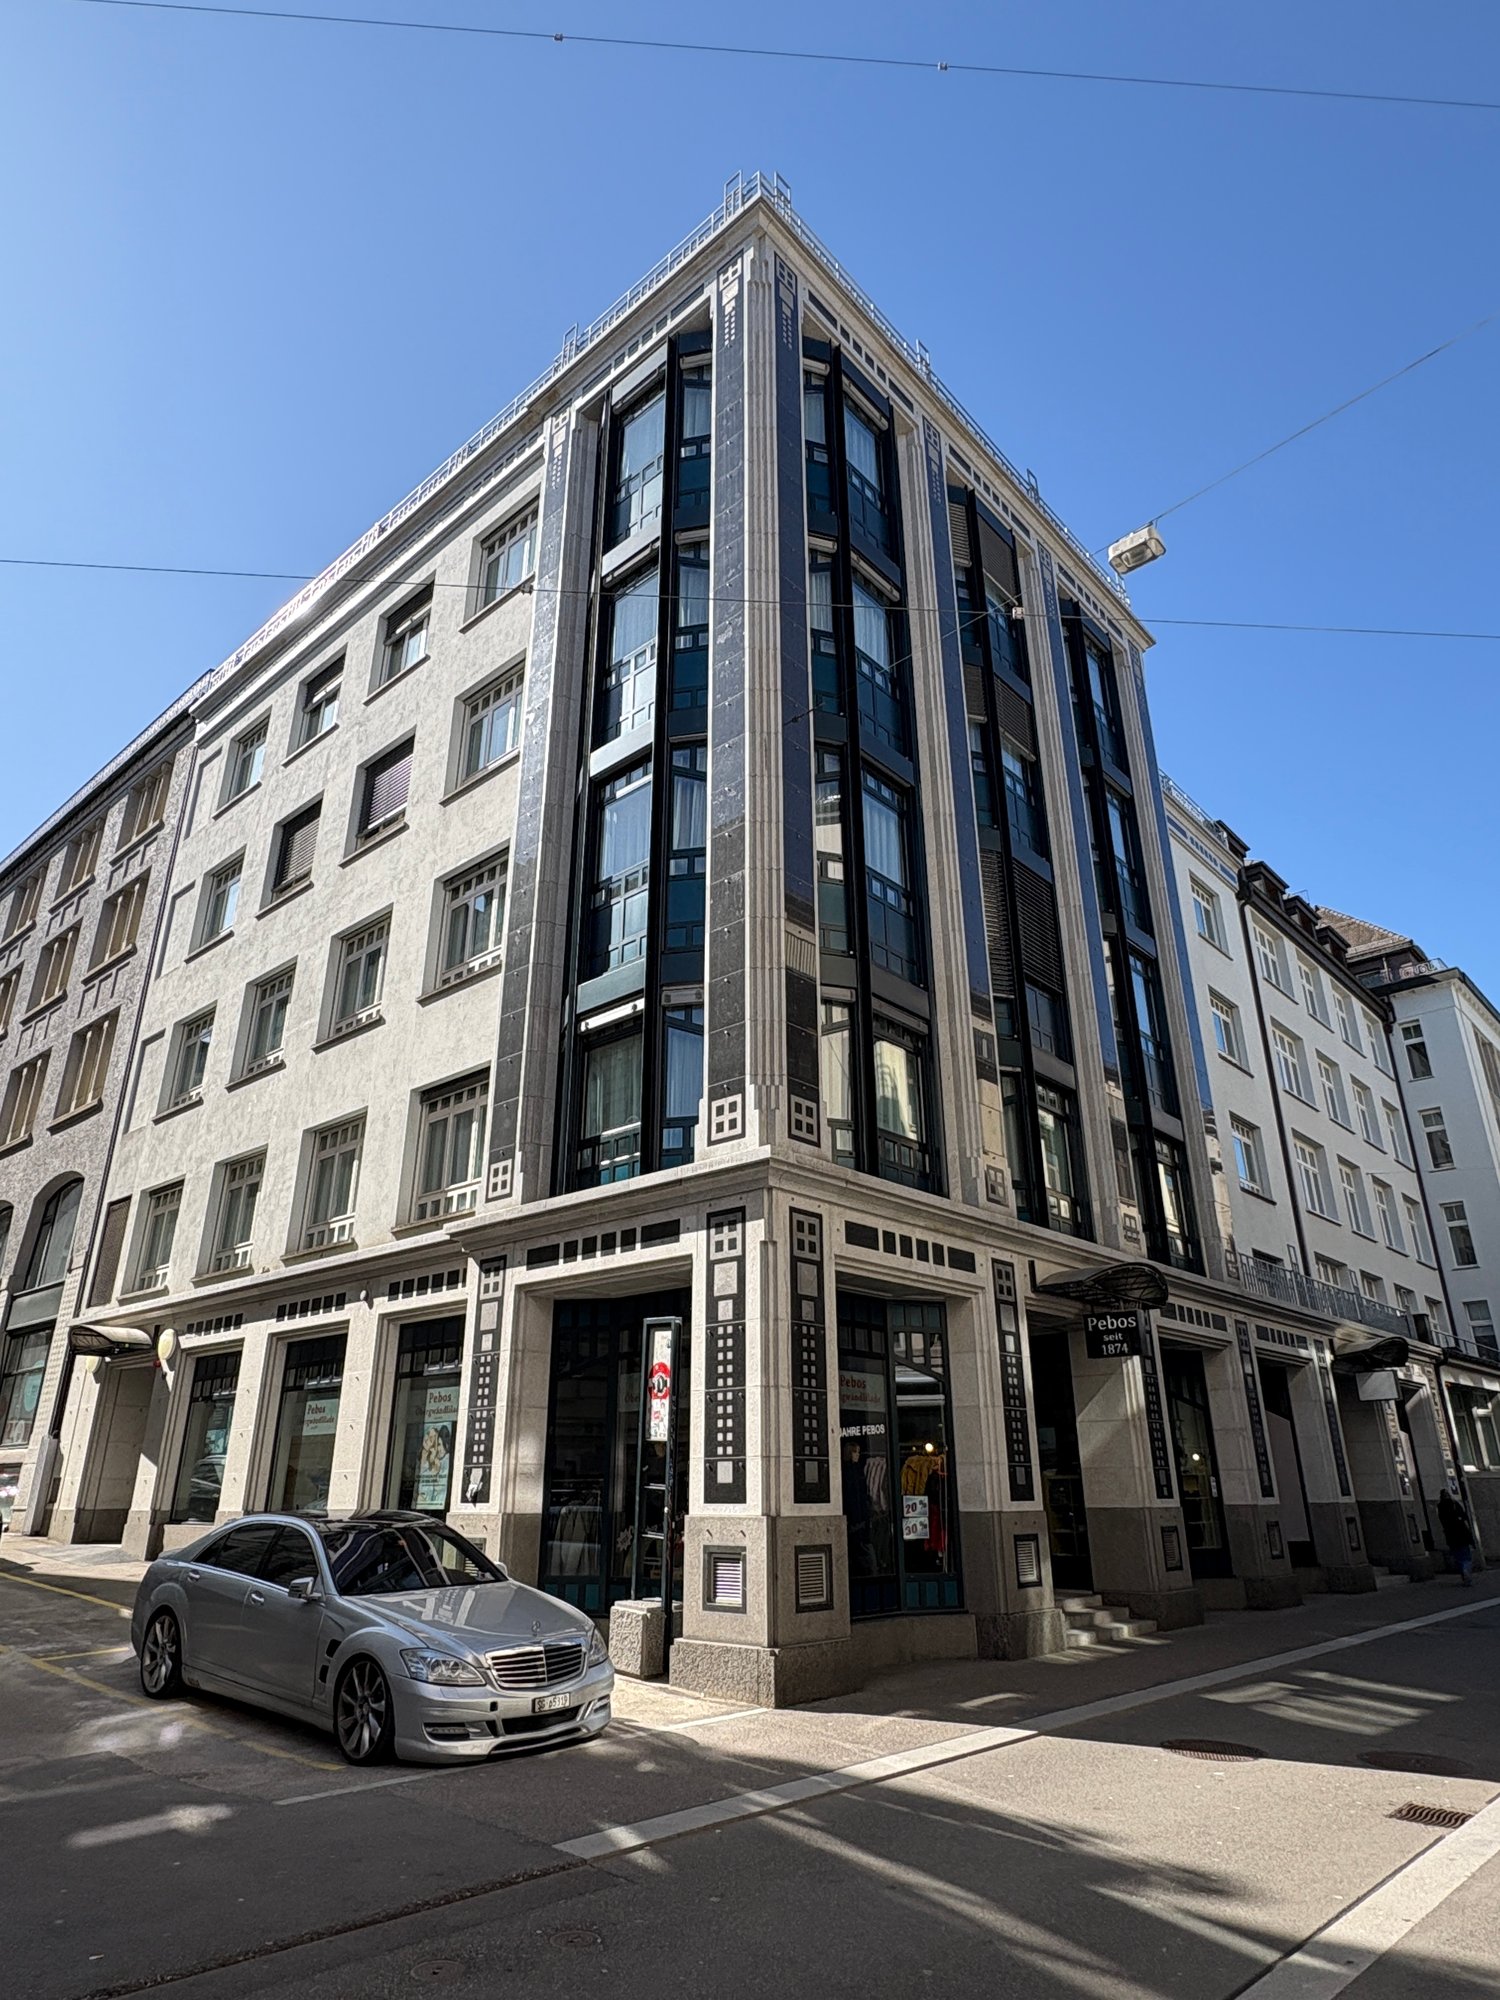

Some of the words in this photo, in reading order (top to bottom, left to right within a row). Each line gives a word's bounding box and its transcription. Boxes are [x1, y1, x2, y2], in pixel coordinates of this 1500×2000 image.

[1087, 1315, 1137, 1331] Pebos
[1103, 1332, 1123, 1341] seit
[1101, 1342, 1129, 1356] 1874
[840, 1375, 866, 1389] Pebos
[428, 1391, 452, 1403] Pebos
[862, 1423, 885, 1435] PEBOS
[904, 1502, 917, 1515] 20
[919, 1499, 927, 1510] %
[904, 1523, 917, 1536] 30
[918, 1520, 928, 1530] %
